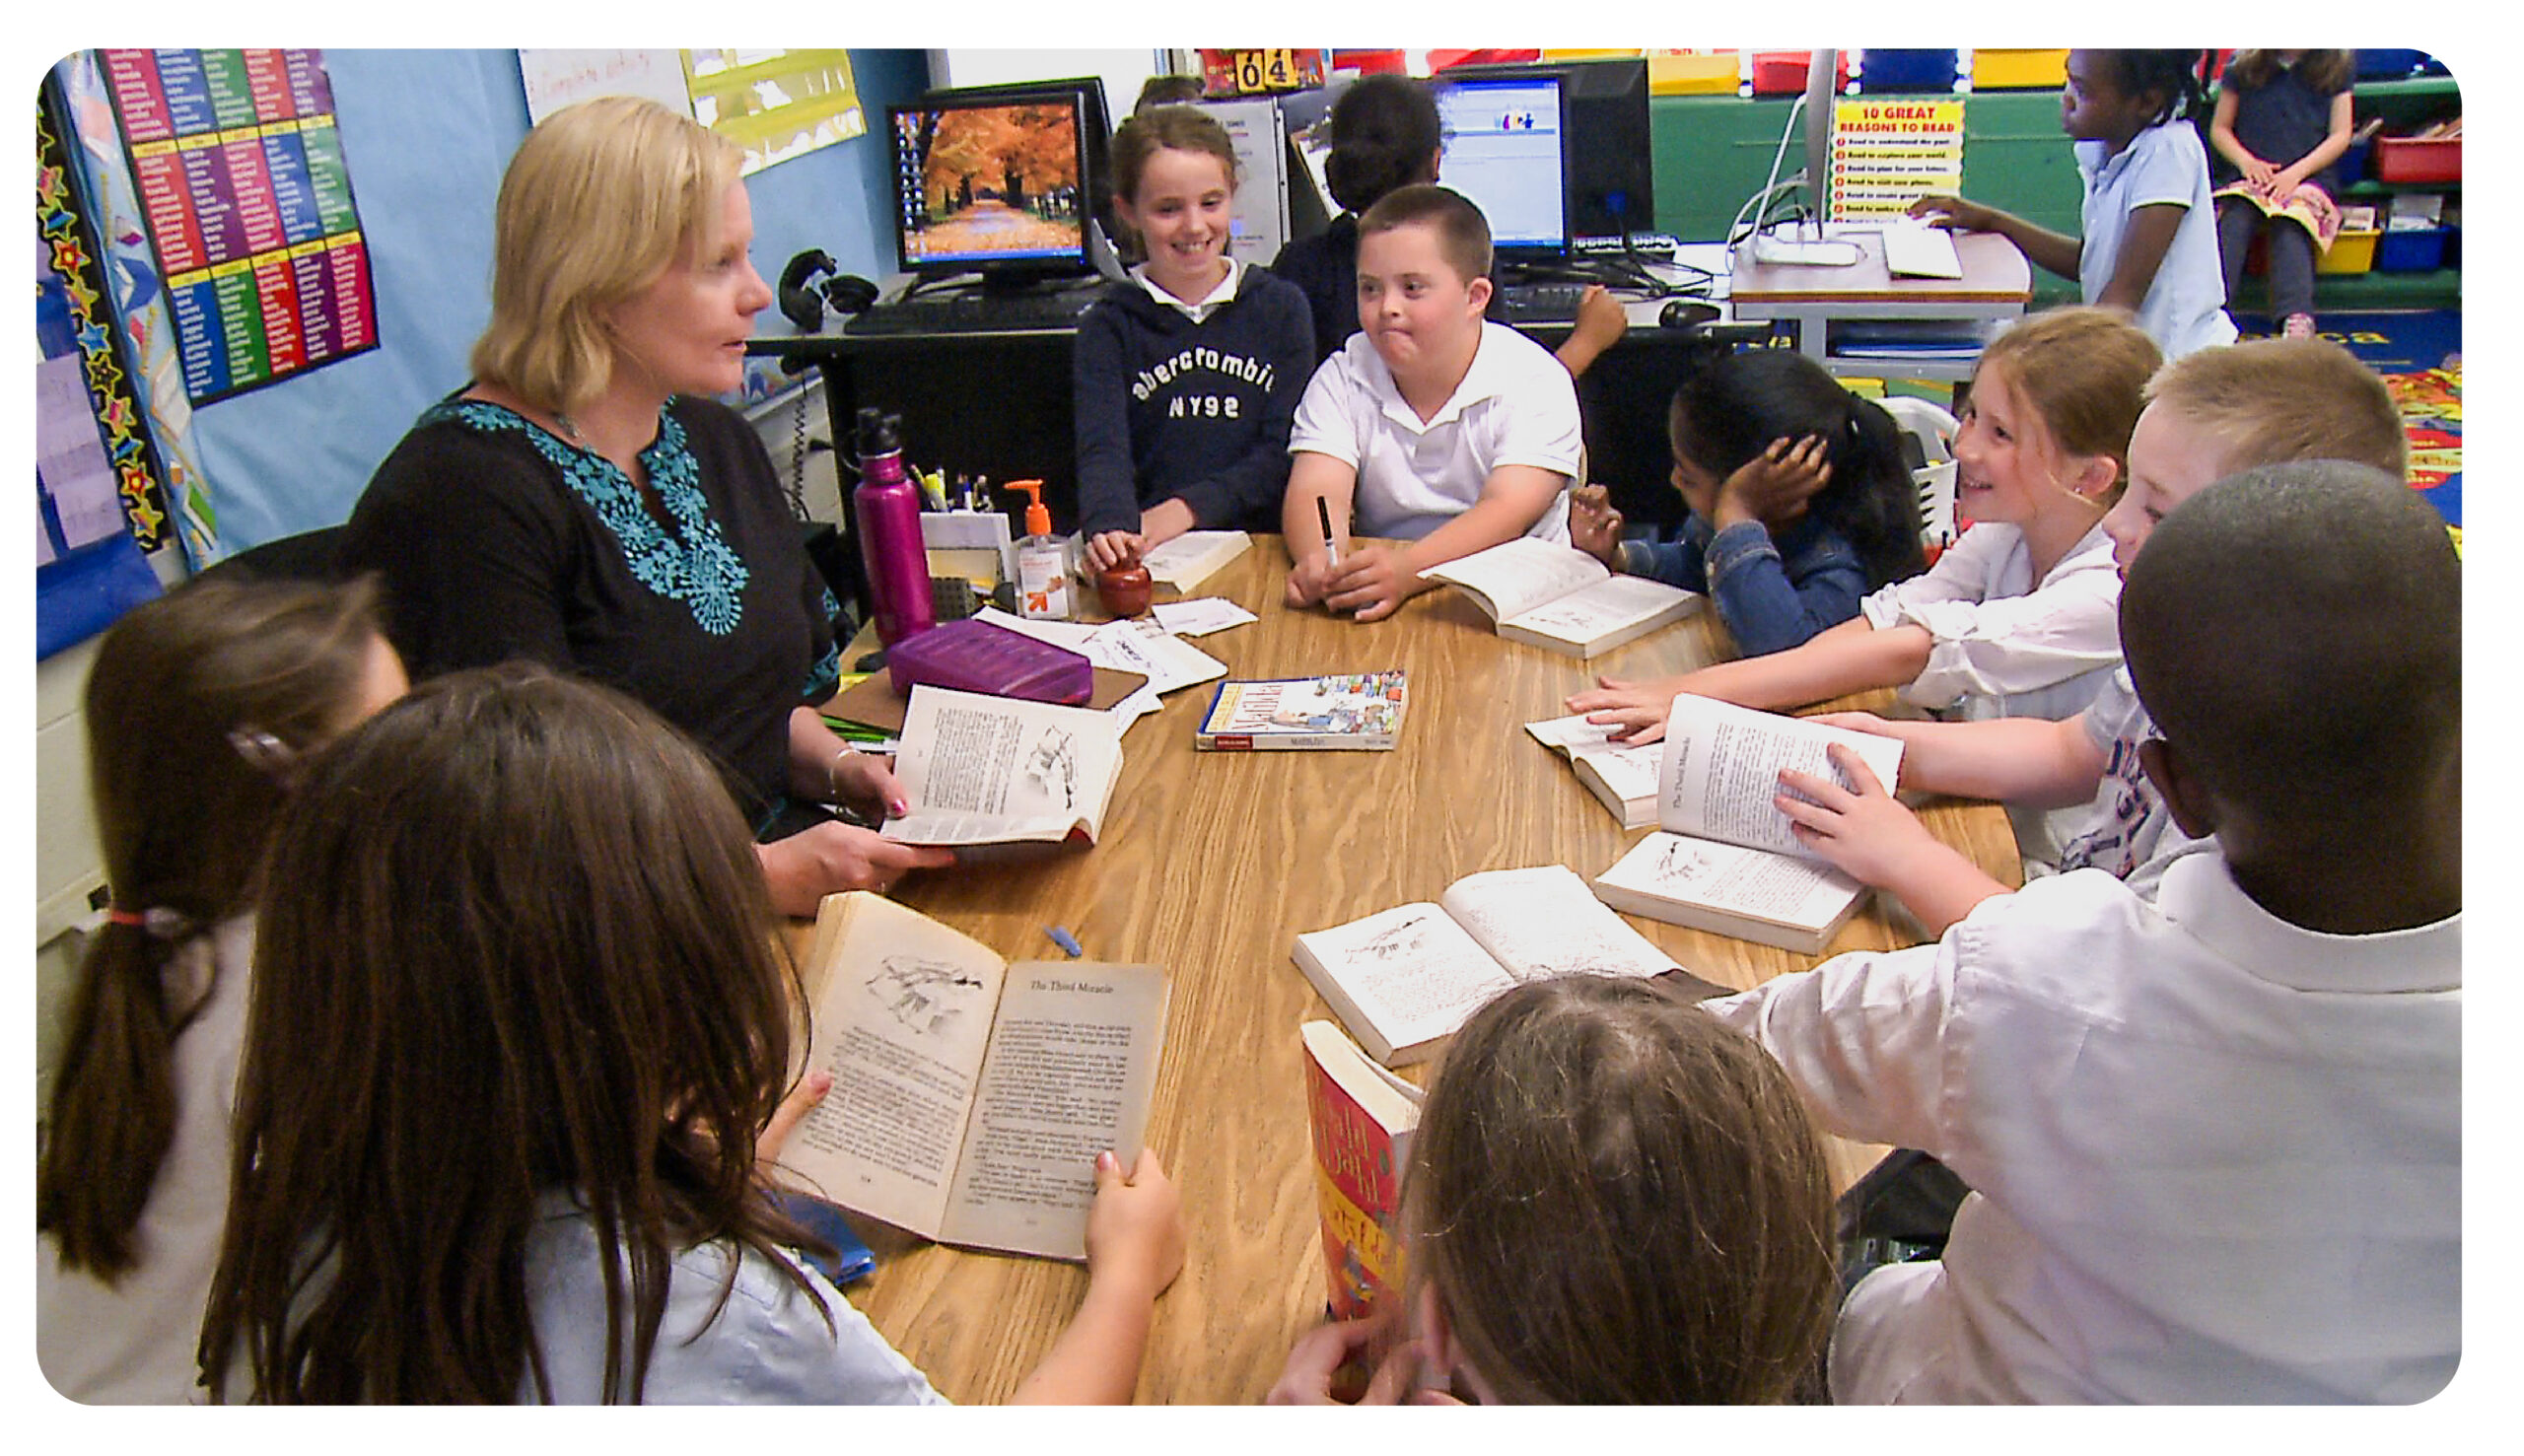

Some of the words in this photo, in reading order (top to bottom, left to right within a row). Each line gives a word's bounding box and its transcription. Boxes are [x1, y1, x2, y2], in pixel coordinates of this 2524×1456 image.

[1863, 107, 1879, 119] 10
[1884, 107, 1935, 119] GREAT
[1840, 123, 1897, 132] REASONS
[1902, 123, 1919, 132] TO
[1923, 123, 1955, 132] READ
[1169, 396, 1238, 418] NY92
[1231, 685, 1285, 730] Matilda
[1031, 980, 1046, 990] The
[1050, 981, 1076, 992] Third
[1079, 983, 1114, 994] Miracle
